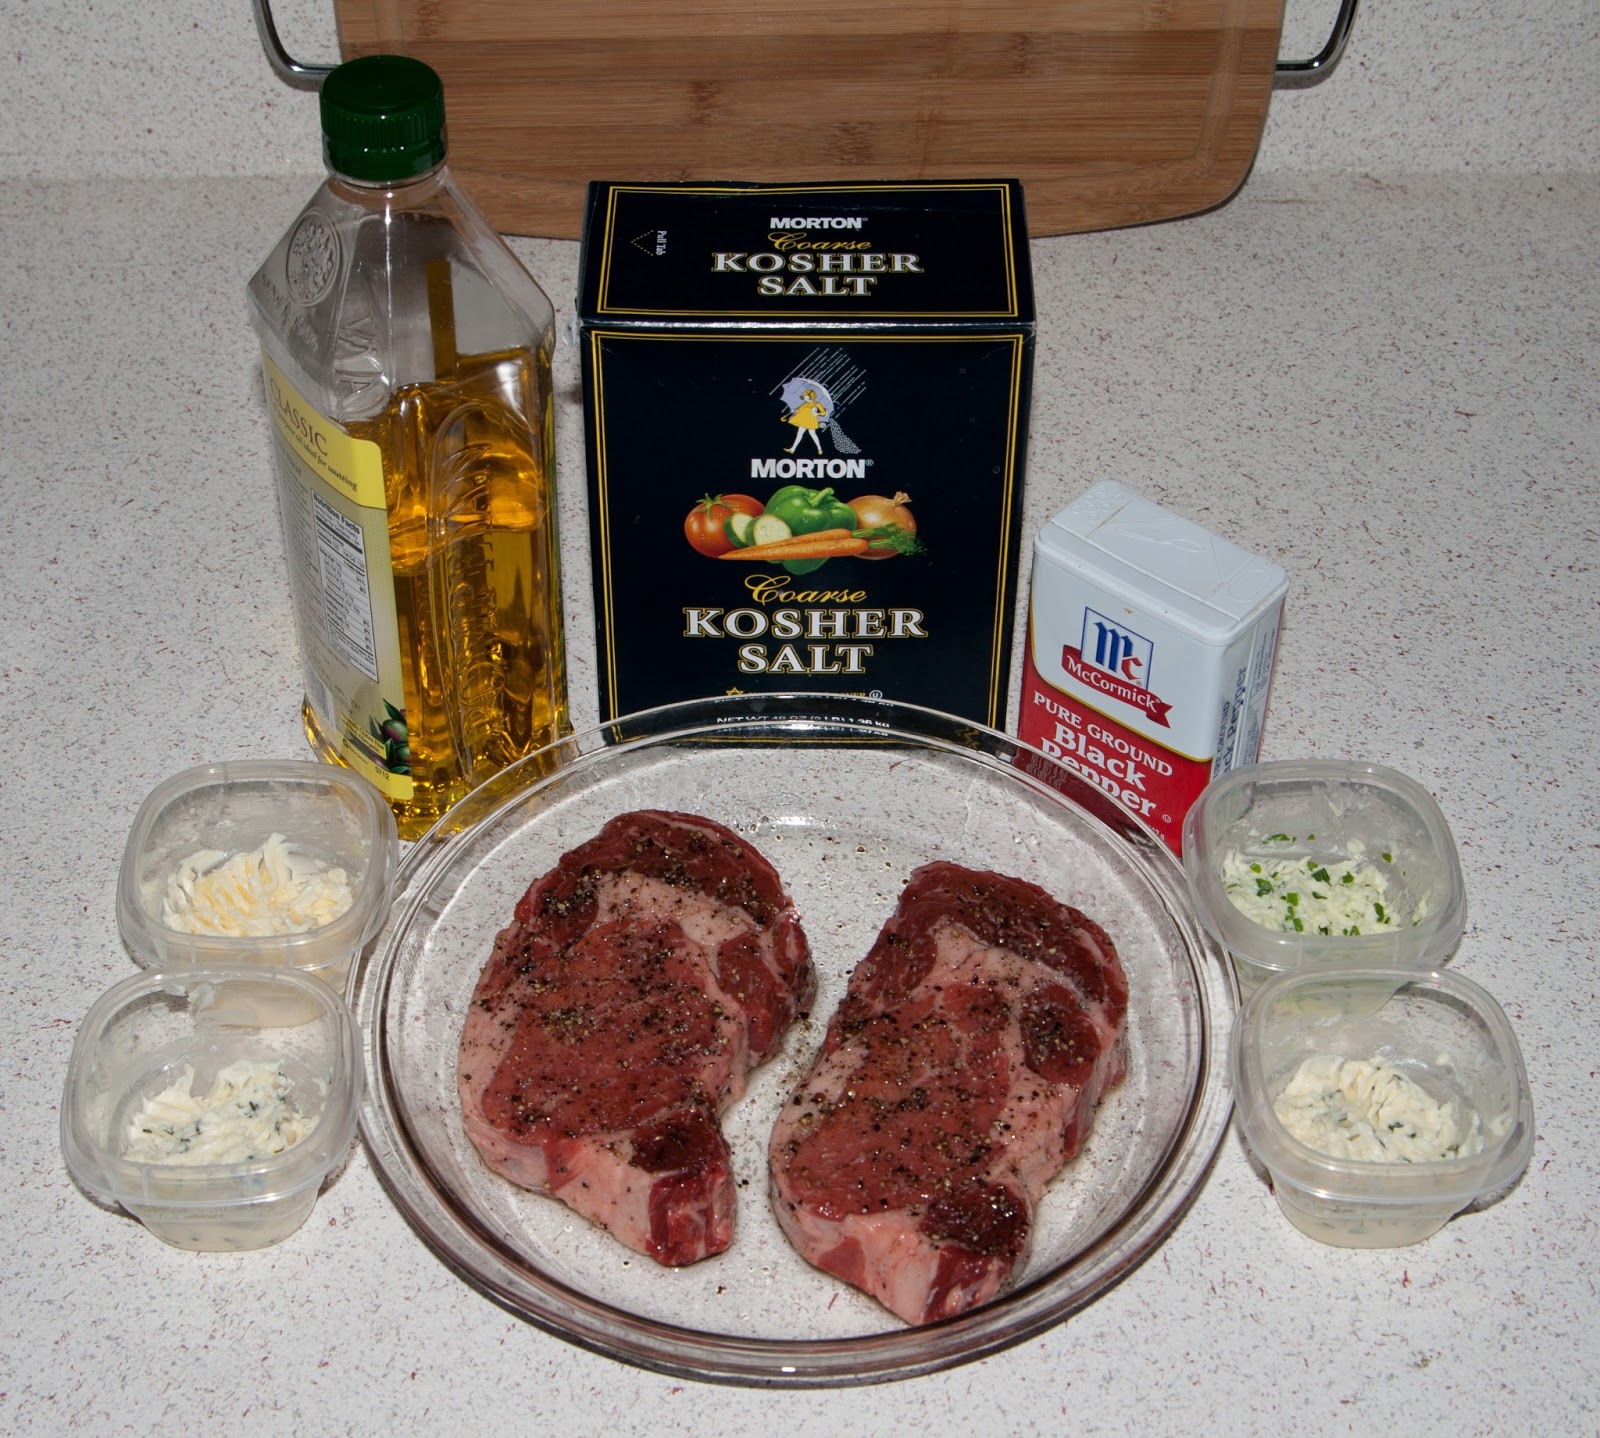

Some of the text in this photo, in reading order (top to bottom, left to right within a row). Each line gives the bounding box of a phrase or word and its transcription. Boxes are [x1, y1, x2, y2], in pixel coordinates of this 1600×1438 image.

[770, 217, 863, 230] MORTON
[656, 230, 667, 256] Pull Tab
[768, 232, 872, 251] Coarse
[711, 252, 925, 273] KOSHER
[757, 275, 878, 297] SALT
[269, 376, 329, 457] CLASSIC
[750, 458, 867, 479] MORTON
[744, 574, 868, 606] Coarse
[682, 606, 929, 640] KOSHER
[737, 643, 875, 675] SALT
[1065, 654, 1159, 714] McCormick
[1033, 690, 1174, 777] PURE GROUND
[1053, 721, 1147, 792] Black
